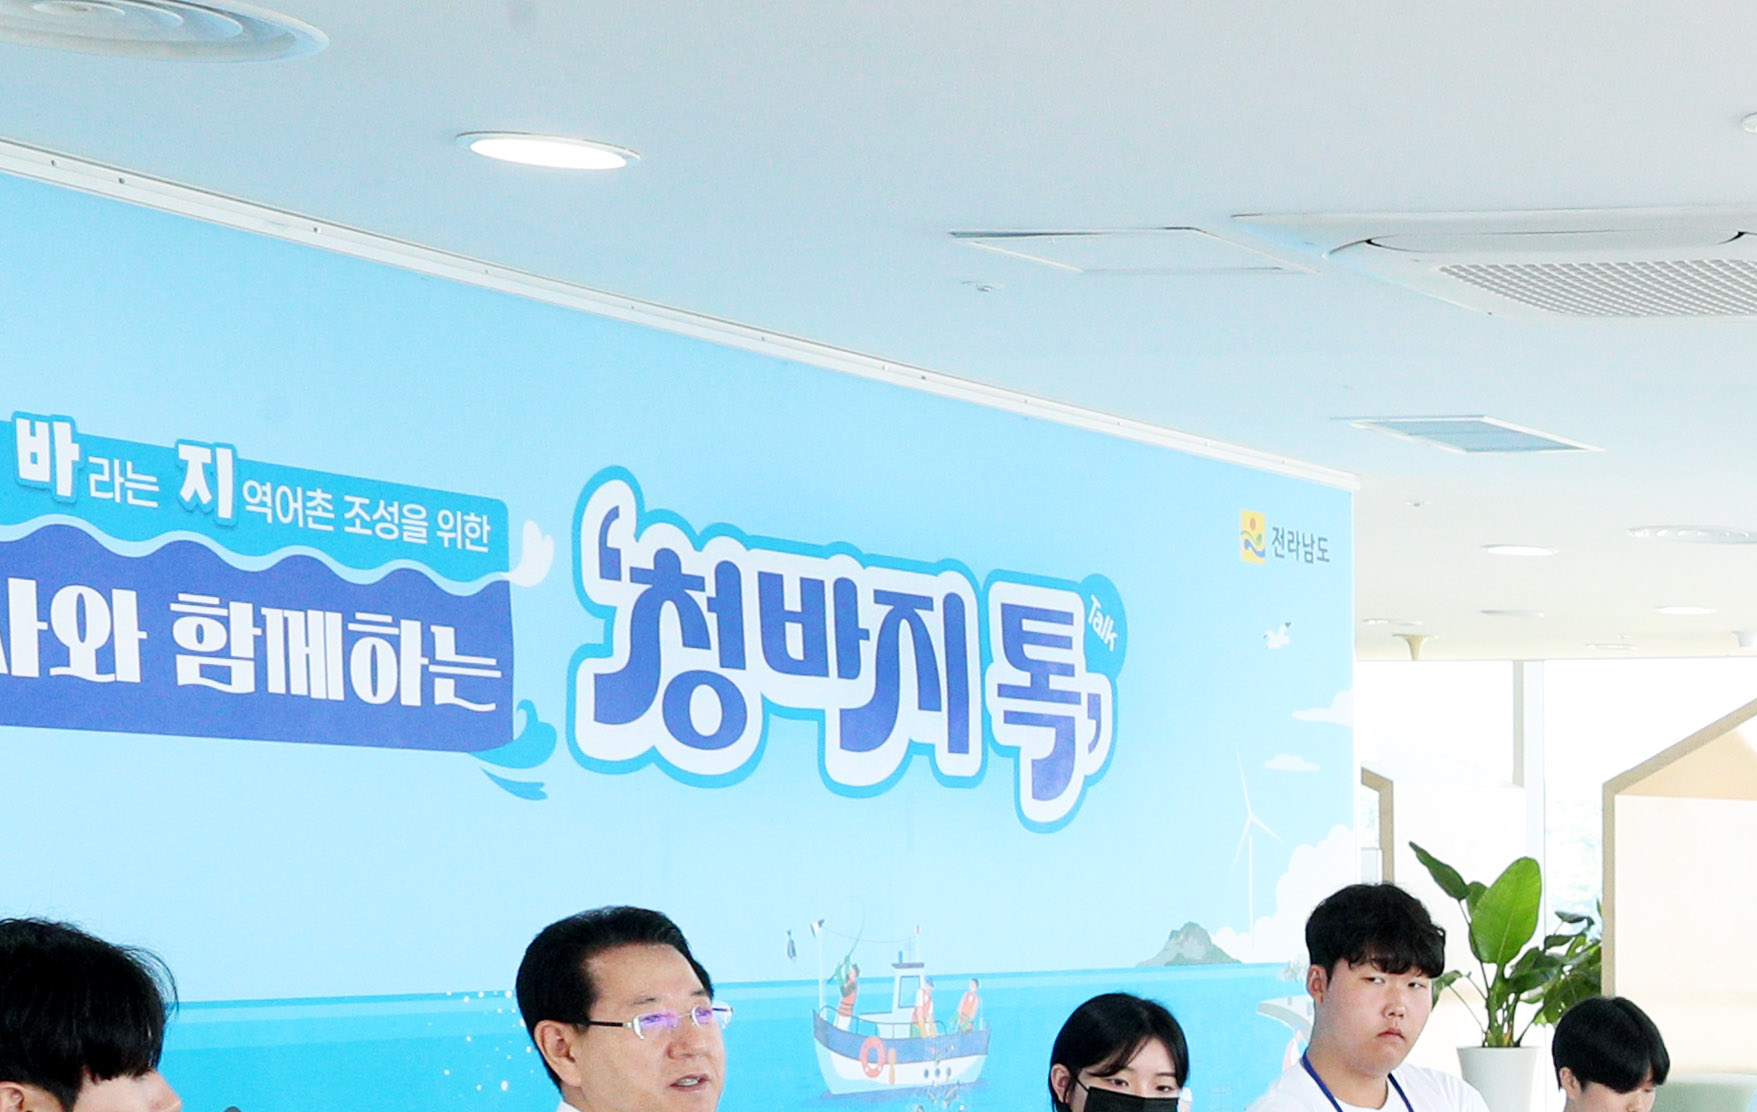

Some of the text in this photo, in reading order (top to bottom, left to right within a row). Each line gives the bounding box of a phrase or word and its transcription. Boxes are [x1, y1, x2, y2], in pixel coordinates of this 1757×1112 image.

[343, 494, 428, 545] 조성을
[436, 510, 491, 553] 위한
[1271, 526, 1331, 565] 전라남도
[1087, 594, 1119, 652] Talk
[170, 592, 502, 713] 함께하는
